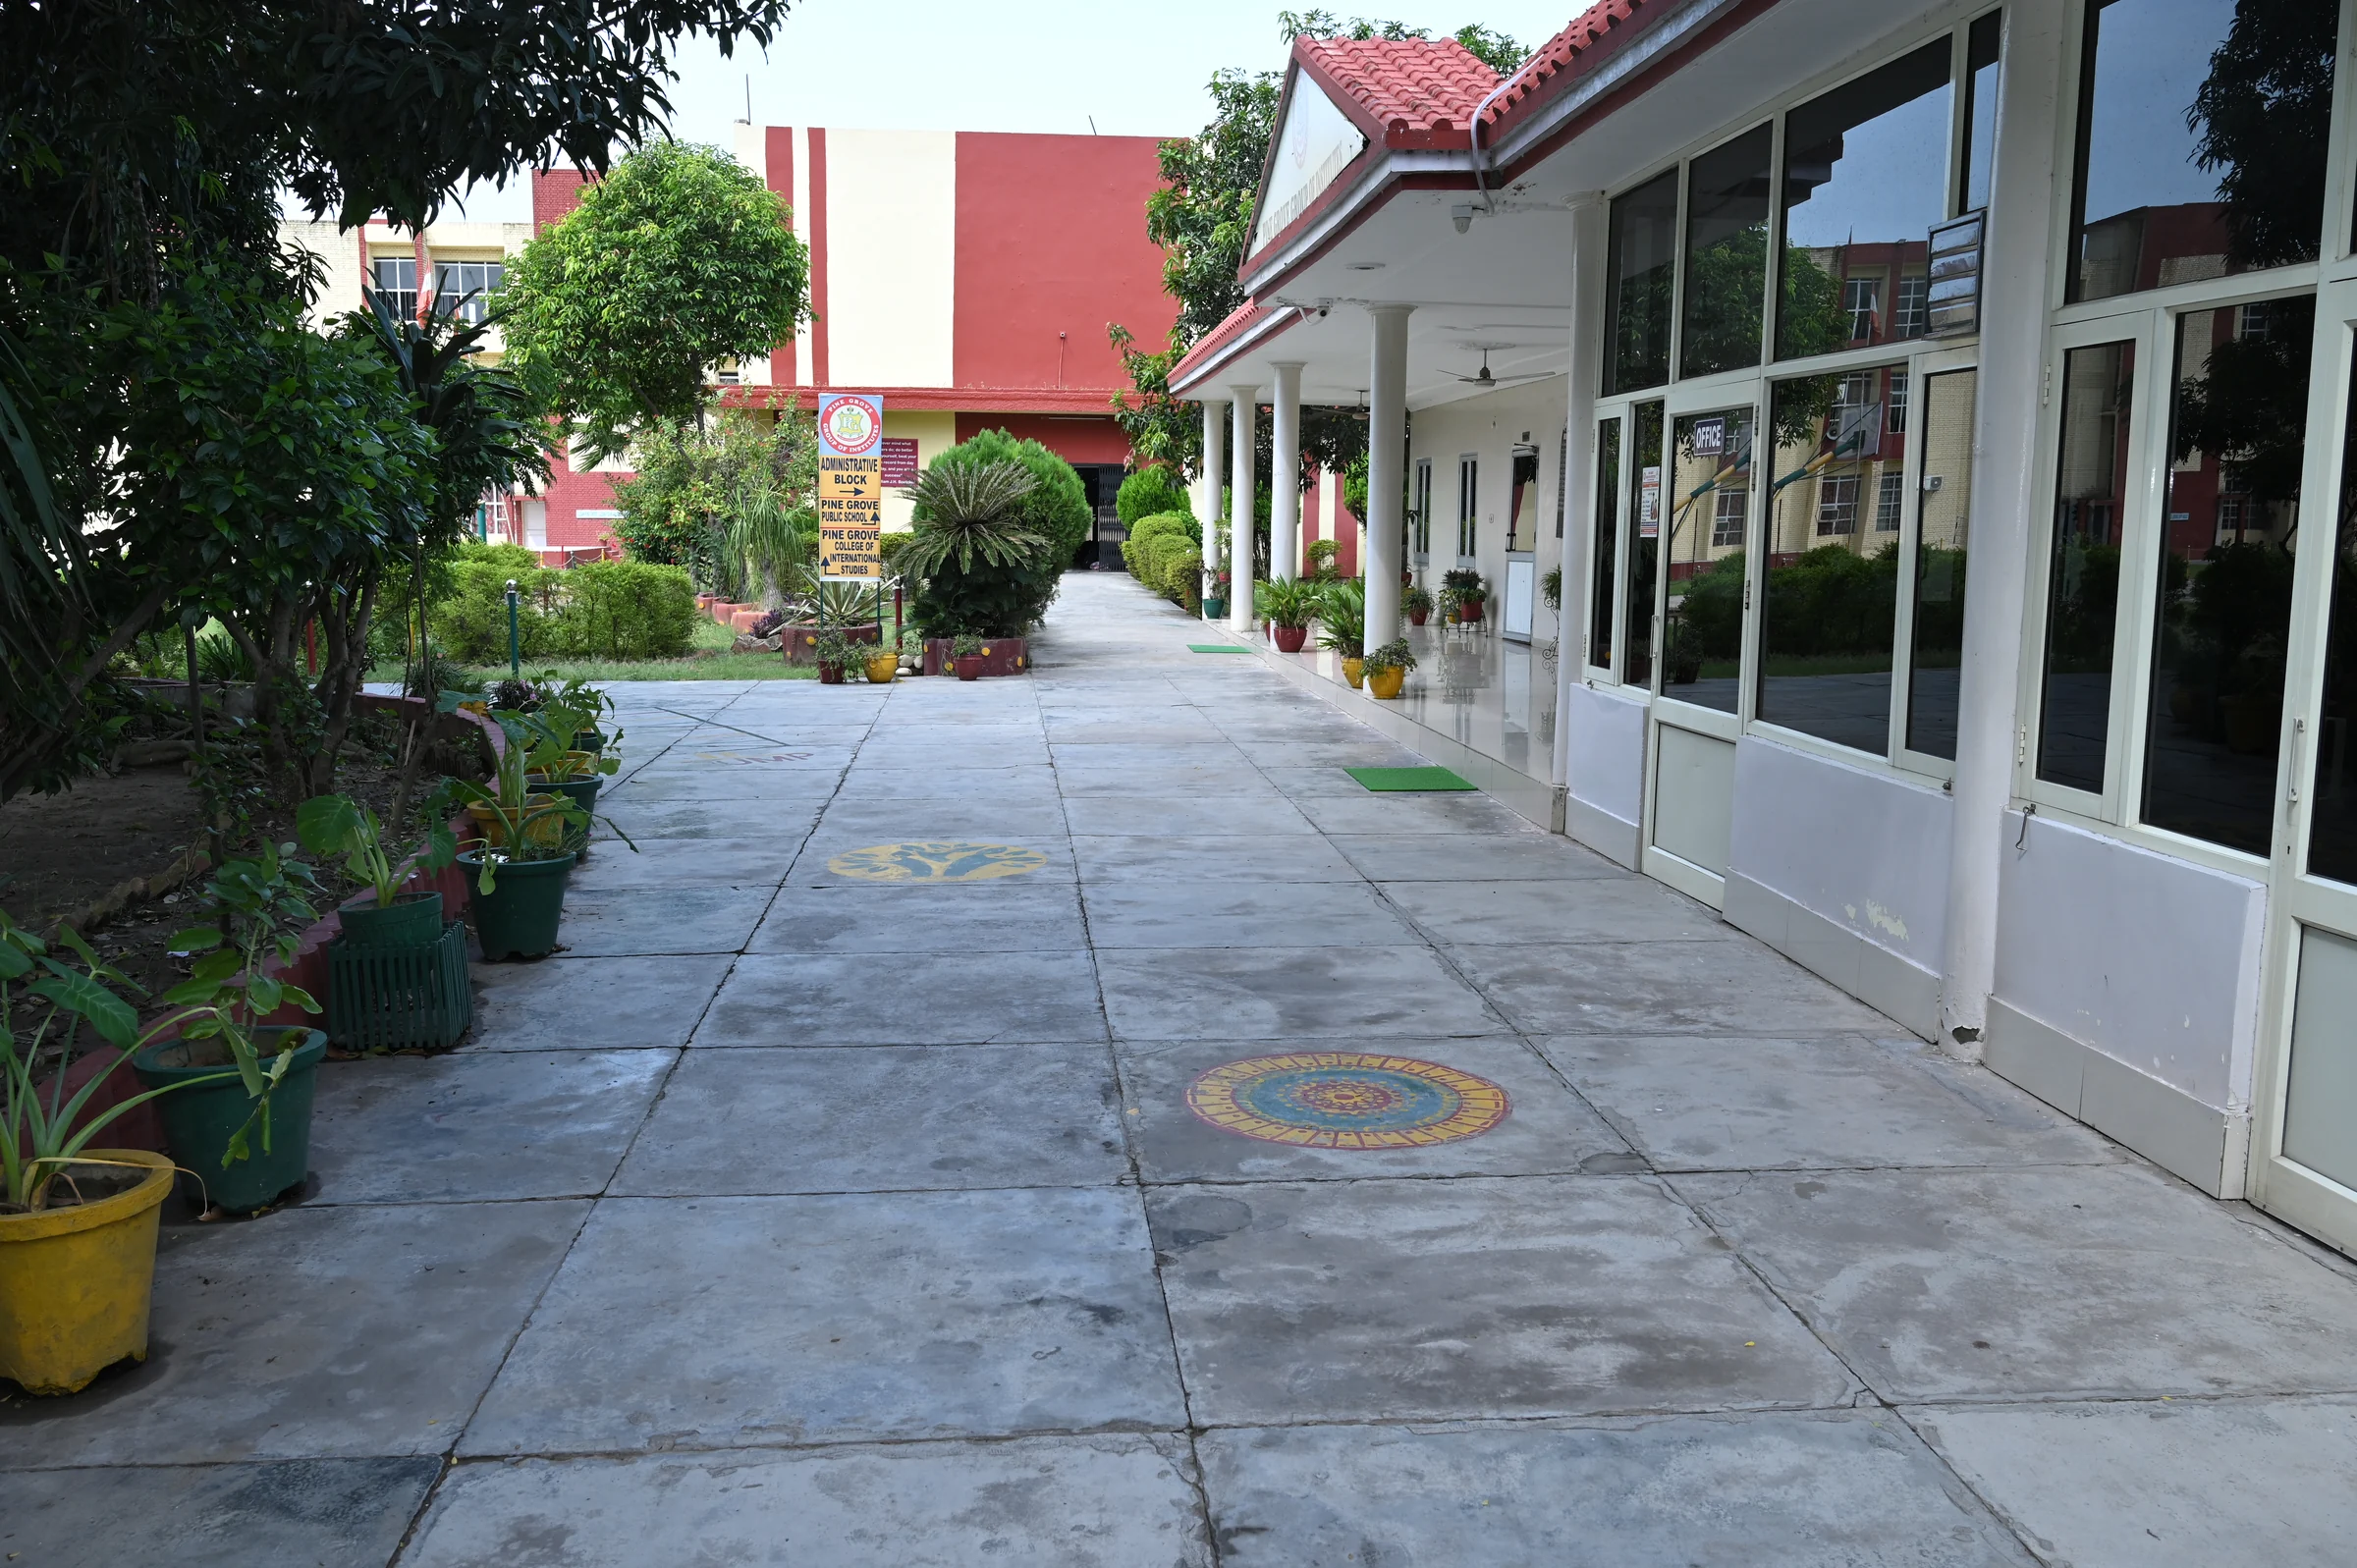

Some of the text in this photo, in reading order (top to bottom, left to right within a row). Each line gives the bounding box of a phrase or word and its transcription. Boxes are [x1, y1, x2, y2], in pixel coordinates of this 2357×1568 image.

[828, 399, 873, 413] PINE GROVE
[823, 423, 838, 446] GROUP
[850, 424, 879, 453] INSTITUTES
[1696, 425, 1722, 449] OFFICE
[821, 458, 878, 472] ADMINISTRATIVE
[835, 474, 867, 485] BLOCK
[822, 500, 879, 510] PINE GROVE
[822, 512, 867, 522] PUBLIC SCHOOL
[823, 530, 879, 540] PINE GROVE
[835, 541, 874, 551] COLLEGE OF
[830, 554, 881, 563] INTERNATIONAL
[841, 566, 868, 574] STUDIES
